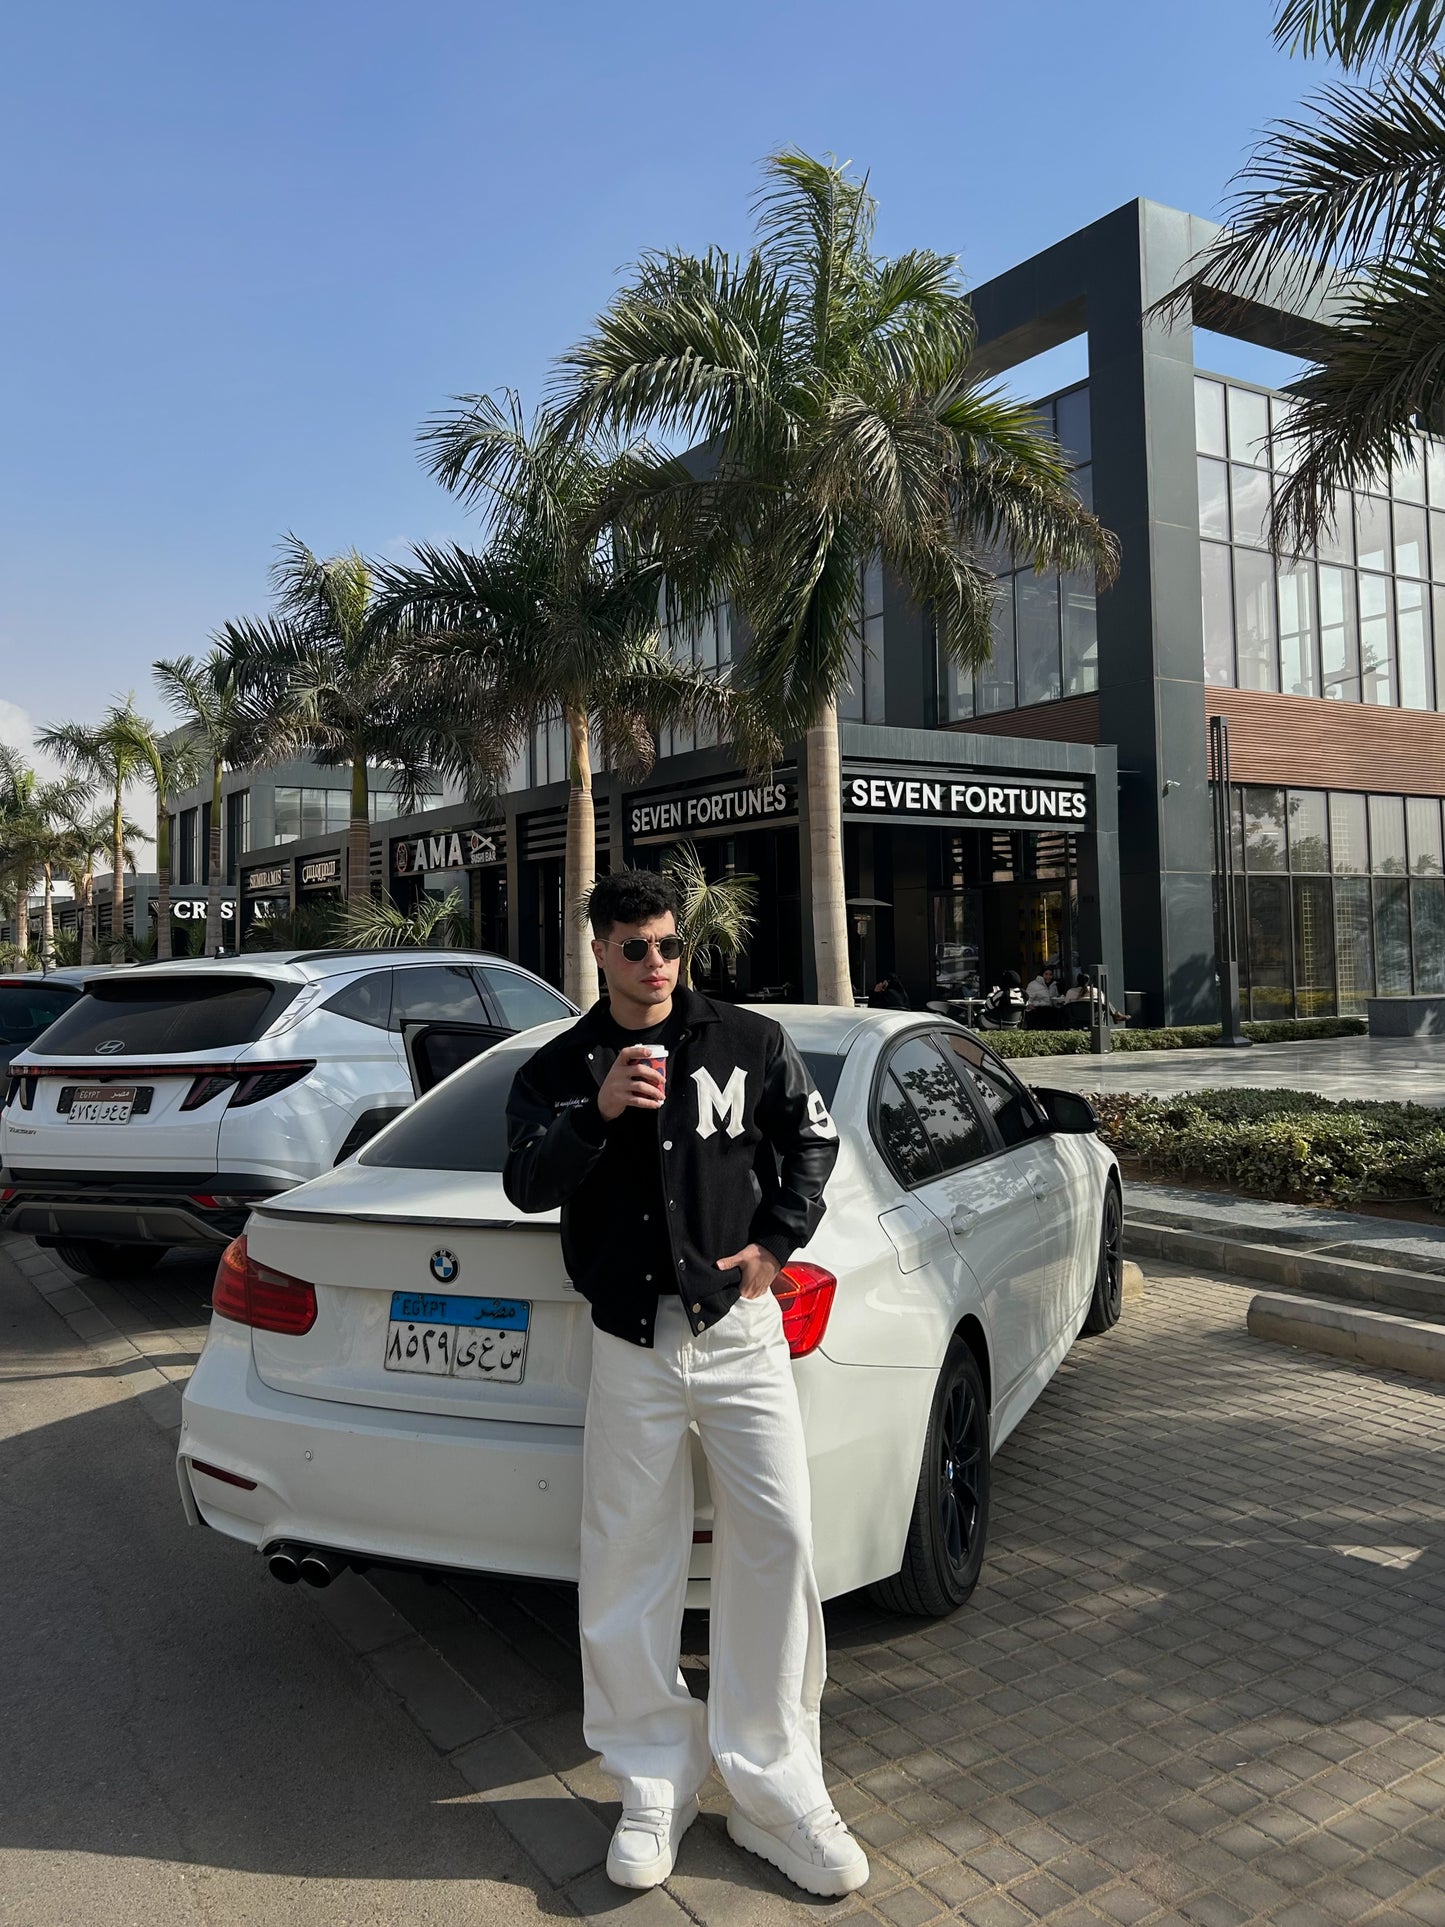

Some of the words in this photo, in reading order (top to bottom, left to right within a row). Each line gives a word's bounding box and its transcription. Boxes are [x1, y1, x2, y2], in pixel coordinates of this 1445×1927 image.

[631, 801, 682, 832] SEVEN
[687, 783, 787, 824] FORTUNES
[851, 778, 942, 811] SEVEN
[950, 784, 1087, 818] FORTUNES
[413, 832, 464, 872] AMA
[485, 850, 497, 862] BAR
[79, 1090, 101, 1099] EGYPT
[110, 1091, 130, 1099] مصر
[690, 1065, 749, 1140] M
[807, 1089, 838, 1140] 9
[402, 1299, 448, 1317] EGYPT
[473, 1306, 517, 1320] مصر
